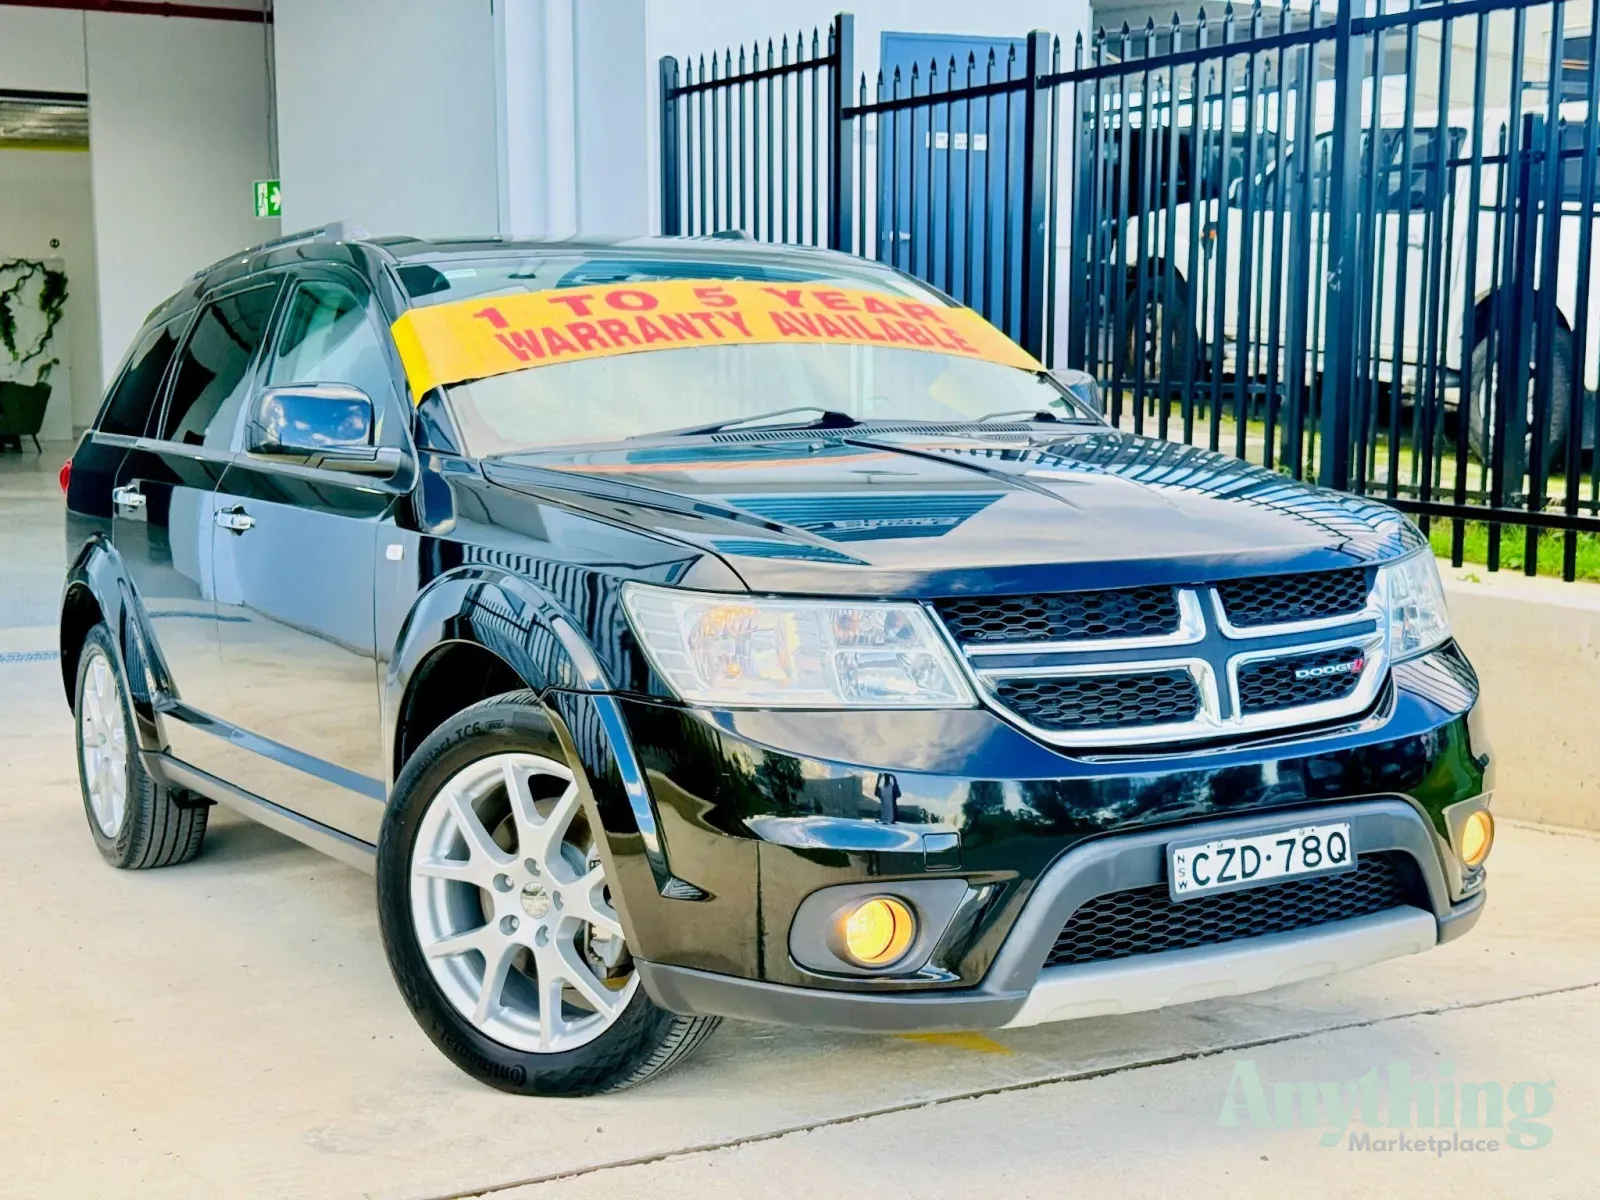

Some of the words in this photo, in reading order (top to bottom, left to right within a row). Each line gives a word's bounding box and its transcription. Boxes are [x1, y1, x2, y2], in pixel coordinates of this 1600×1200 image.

[473, 307, 510, 329] 1
[547, 289, 659, 317] TO
[693, 286, 738, 308] 5
[759, 287, 947, 324] YEAR
[494, 311, 754, 362] WARRANTY
[769, 311, 982, 354] AVAILABLE
[1295, 661, 1355, 678] DODGE
[1177, 854, 1188, 890] NSW
